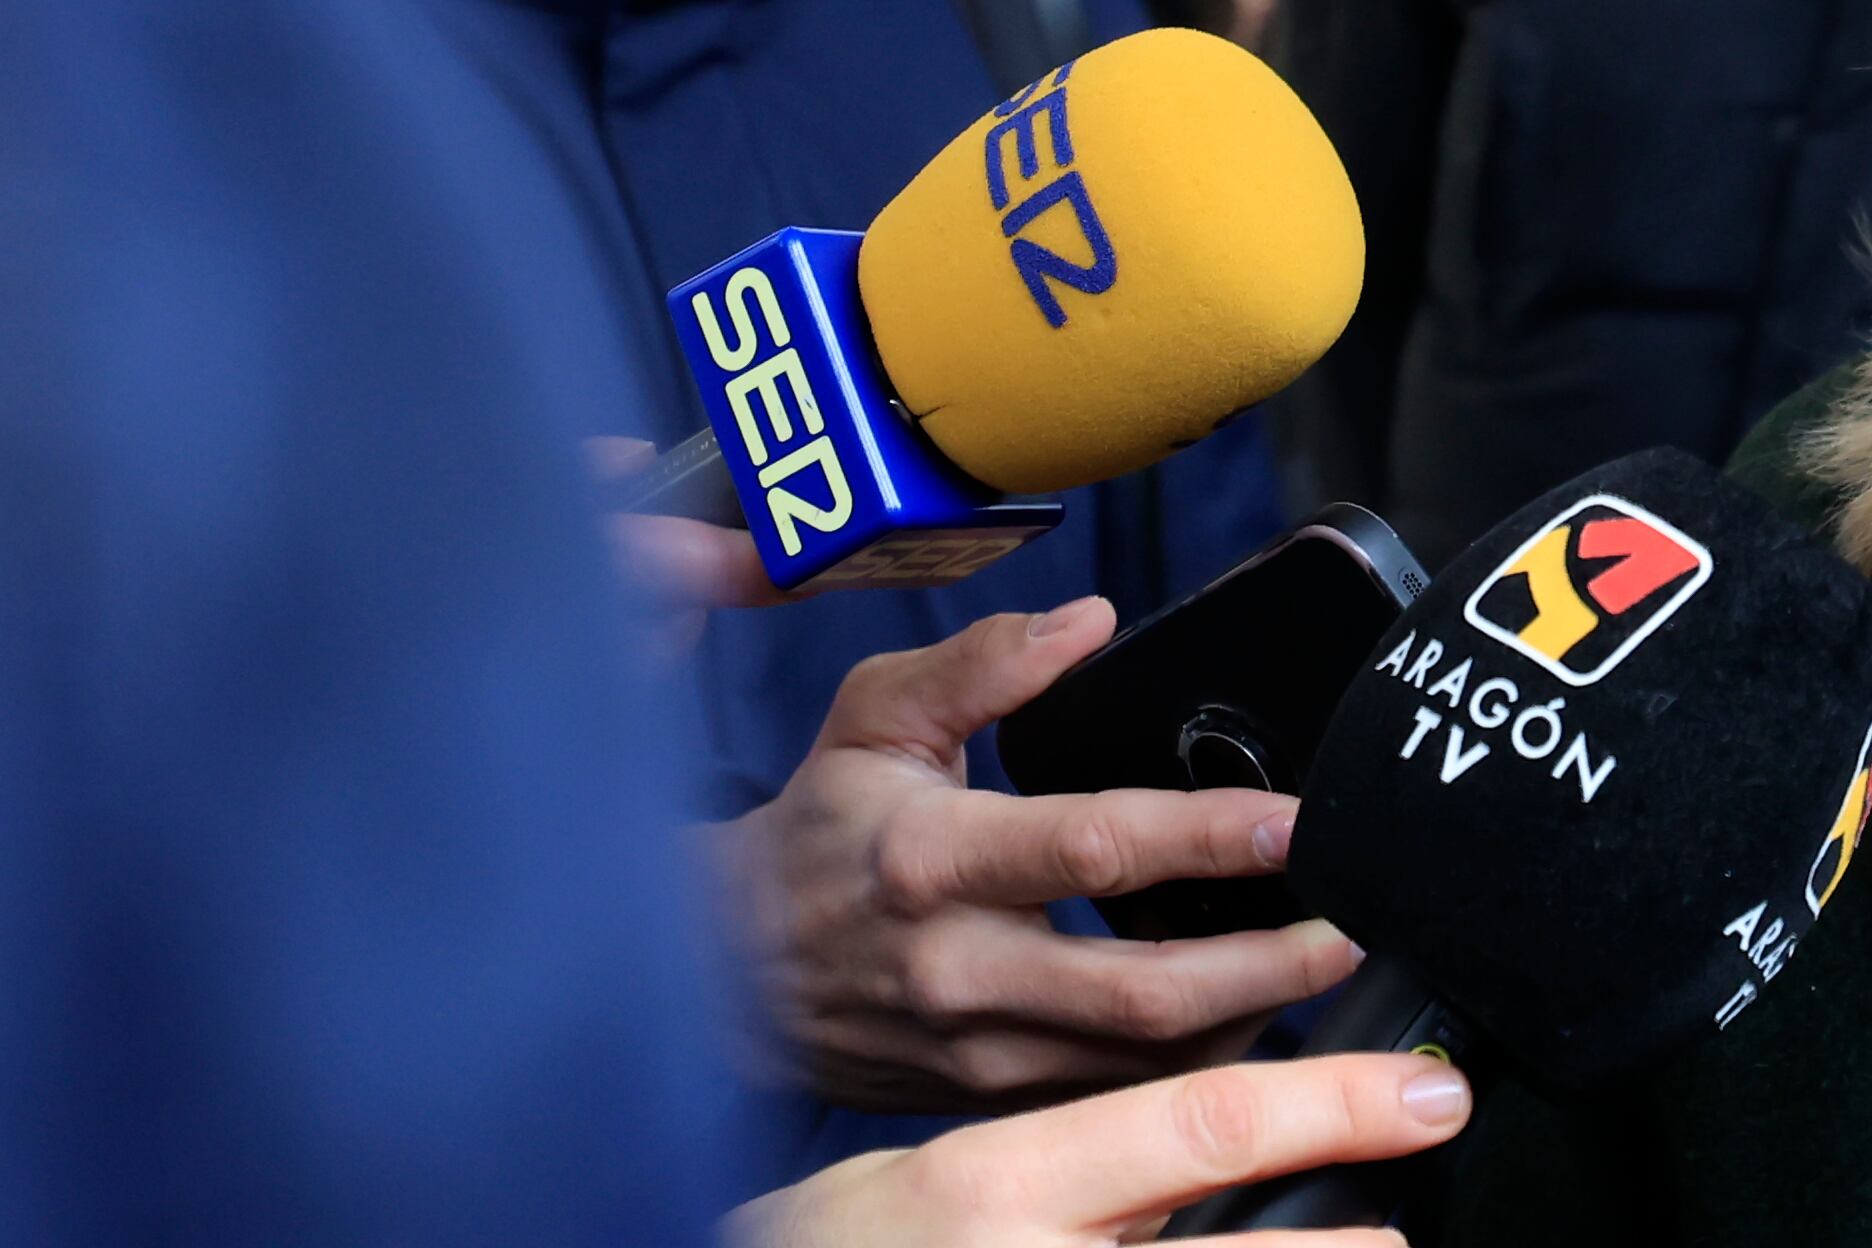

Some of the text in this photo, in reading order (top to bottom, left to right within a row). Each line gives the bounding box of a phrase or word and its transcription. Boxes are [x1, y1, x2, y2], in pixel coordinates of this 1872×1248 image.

[692, 266, 854, 558] SER
[1374, 630, 1618, 804] ARAGÓN
[1399, 704, 1491, 785] TV
